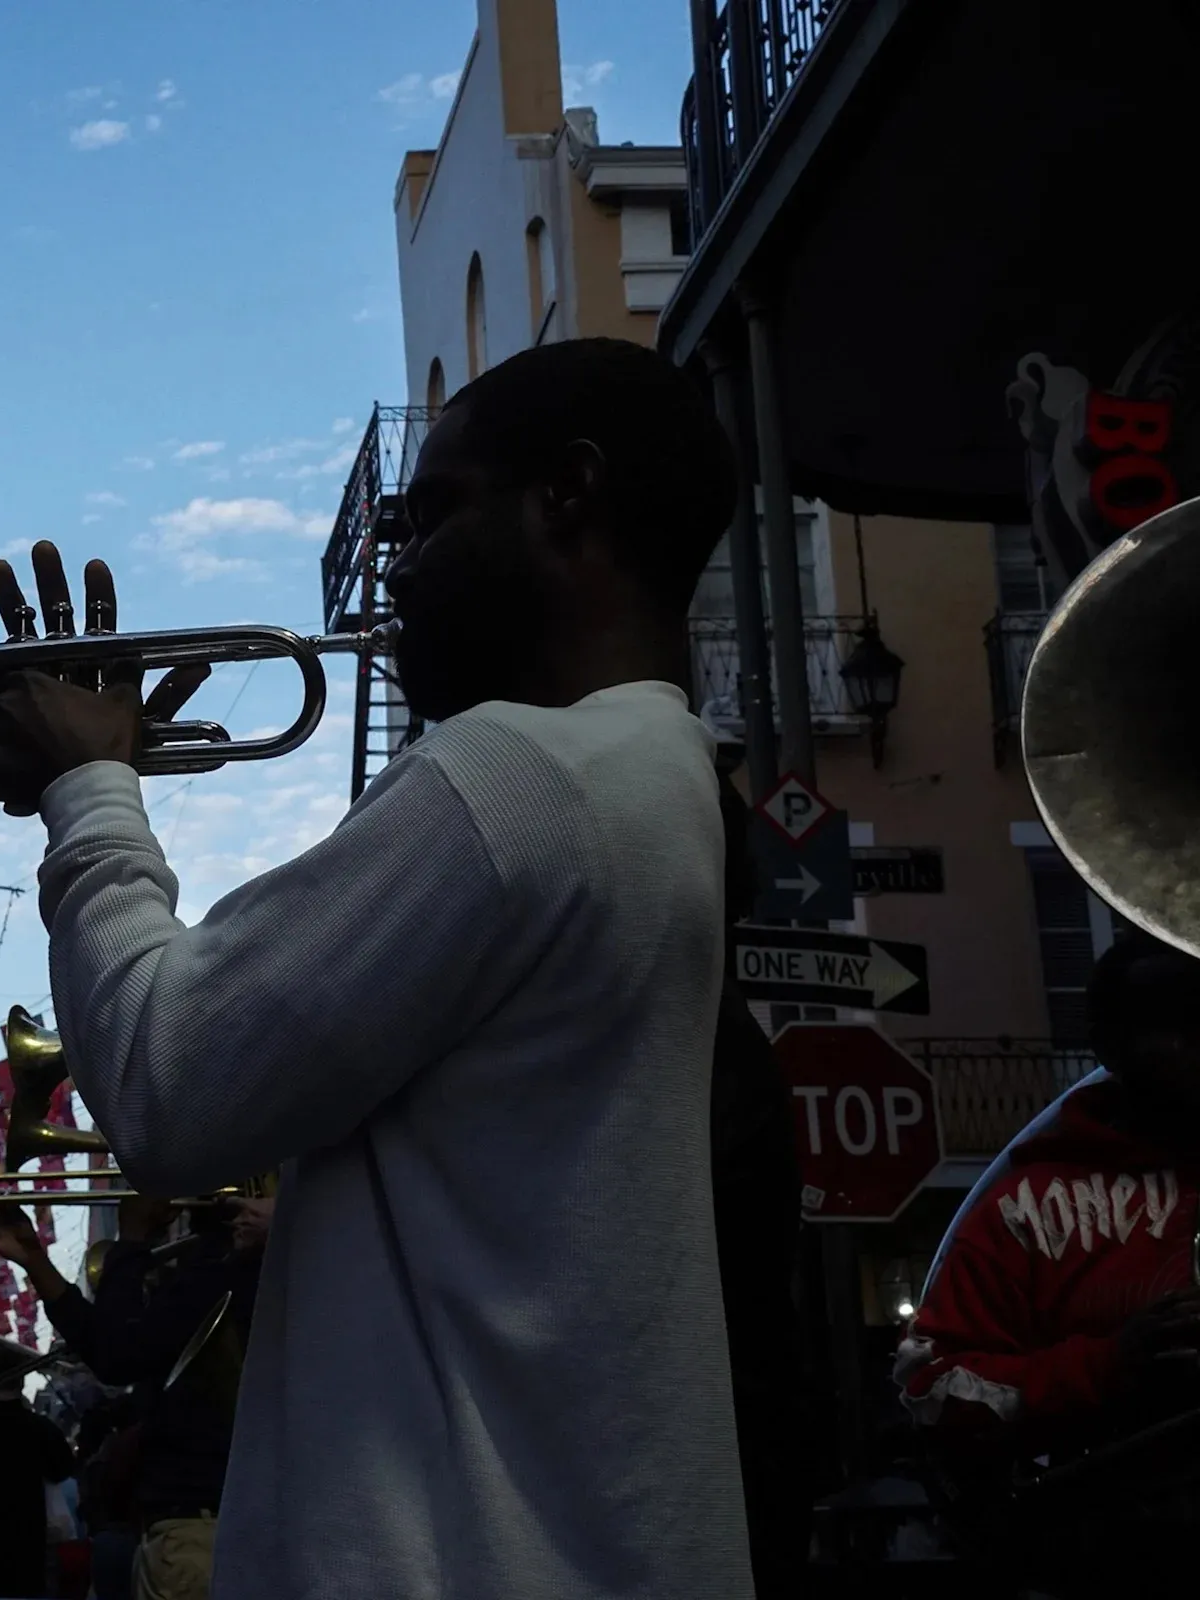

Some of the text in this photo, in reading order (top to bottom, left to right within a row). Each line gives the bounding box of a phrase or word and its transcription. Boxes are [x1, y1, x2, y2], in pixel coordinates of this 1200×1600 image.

[784, 793, 811, 827] P
[743, 949, 871, 988] ONE WAY
[792, 1084, 924, 1157] TOP
